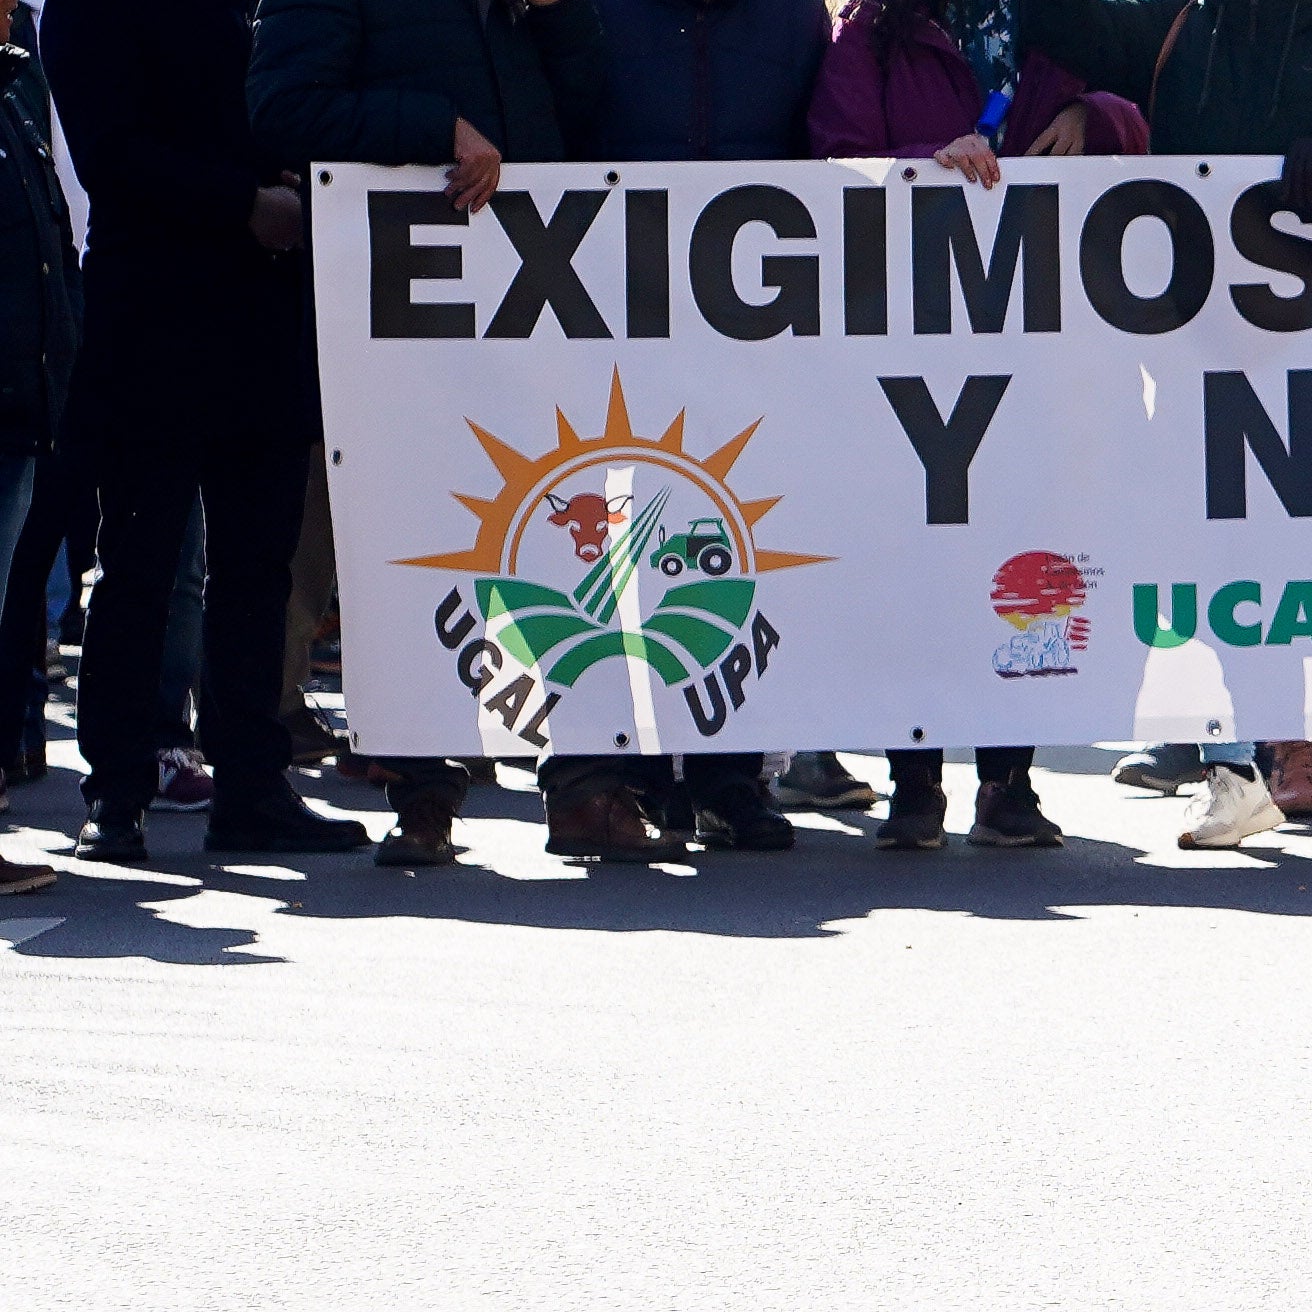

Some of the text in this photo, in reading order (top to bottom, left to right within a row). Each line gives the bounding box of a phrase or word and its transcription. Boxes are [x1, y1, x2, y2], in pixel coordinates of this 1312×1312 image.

[876, 374, 1013, 525] Y
[434, 587, 571, 751] UGAL
[682, 609, 780, 738] UPA
